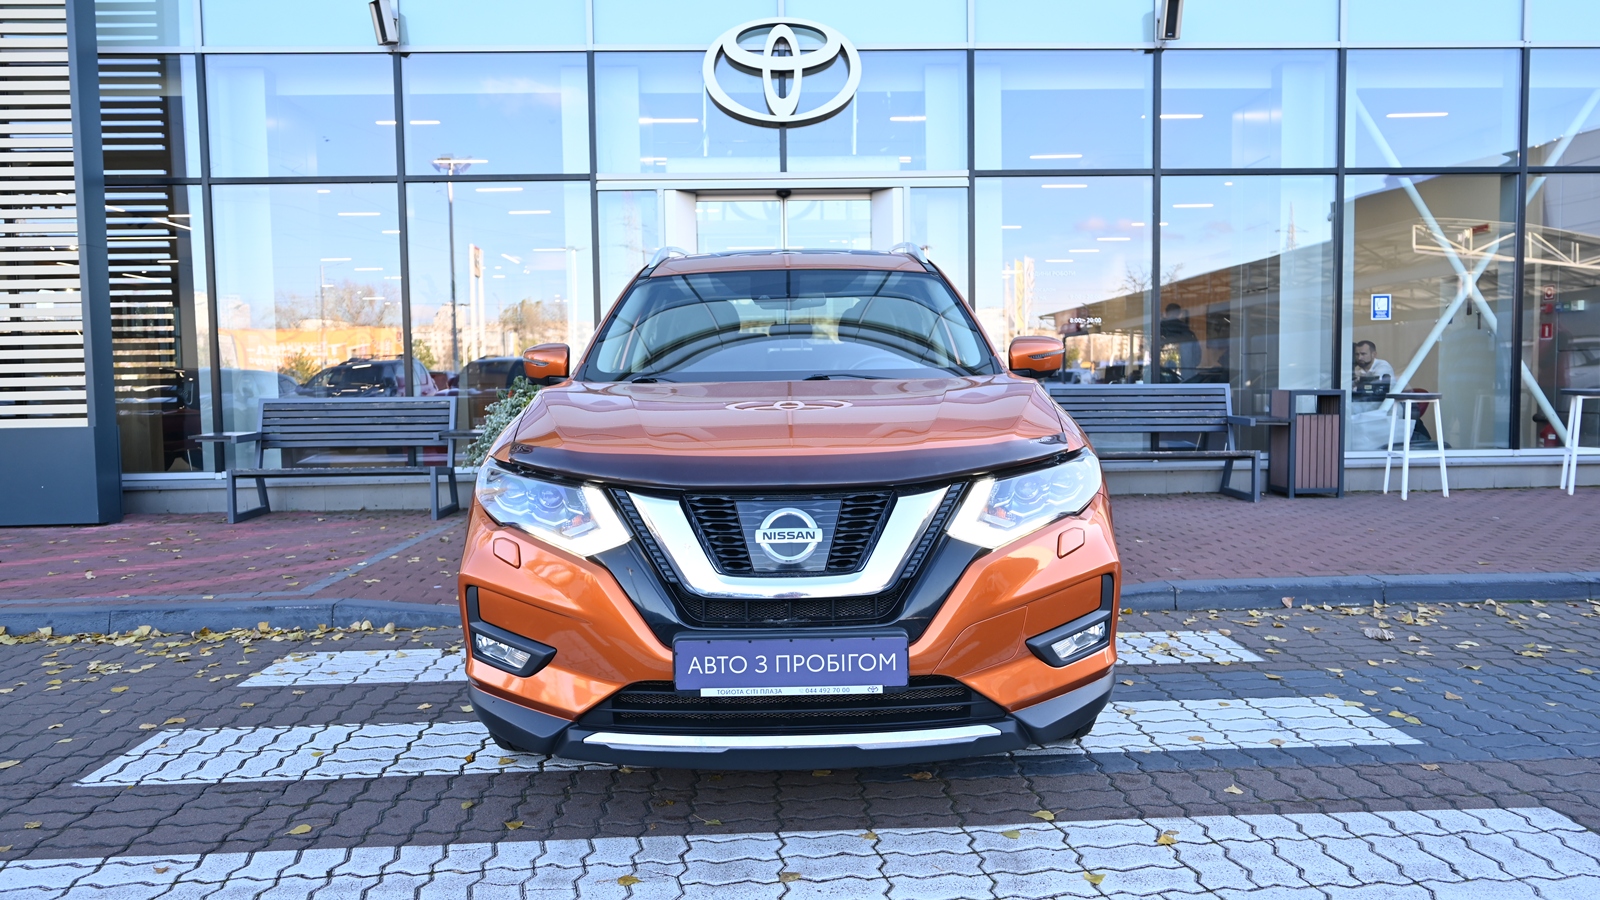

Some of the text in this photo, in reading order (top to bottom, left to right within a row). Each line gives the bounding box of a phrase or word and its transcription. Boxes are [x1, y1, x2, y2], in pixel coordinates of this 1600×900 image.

[762, 531, 816, 541] NISSAN
[687, 653, 897, 675] АВТО З ПРОБІГОМ
